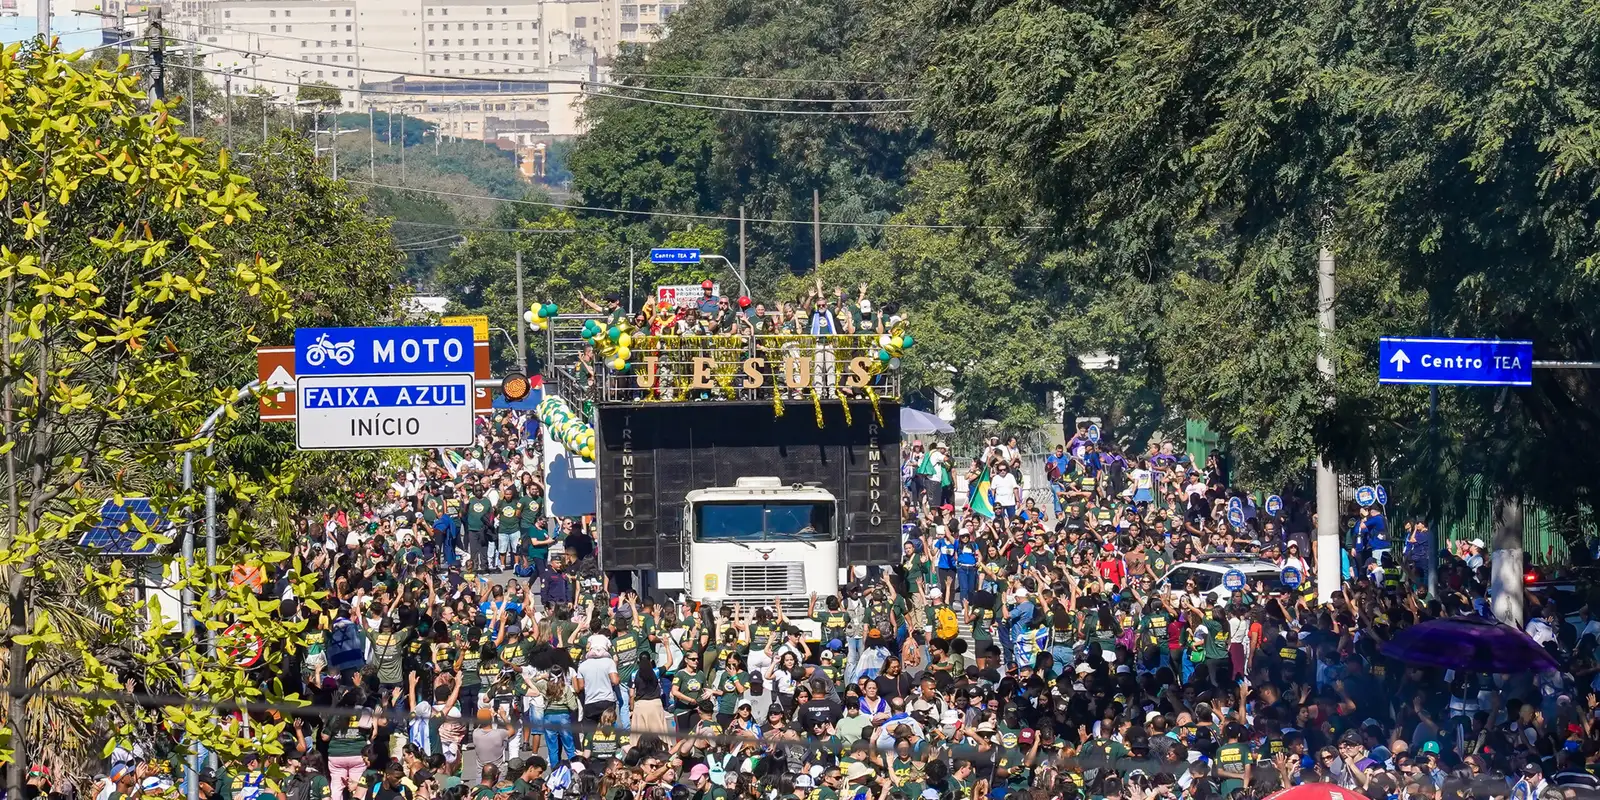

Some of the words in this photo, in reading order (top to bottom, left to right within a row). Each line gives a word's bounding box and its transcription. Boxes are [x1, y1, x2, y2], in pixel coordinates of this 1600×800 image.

[373, 338, 463, 364] MOTO
[1420, 354, 1483, 369] Centro
[1493, 356, 1522, 370] TEA
[637, 355, 872, 389] JESUS
[305, 387, 380, 407] FAIXA
[395, 386, 465, 405] AZUL
[351, 413, 420, 437] INÍCIO
[622, 415, 635, 531] TREMENDAO
